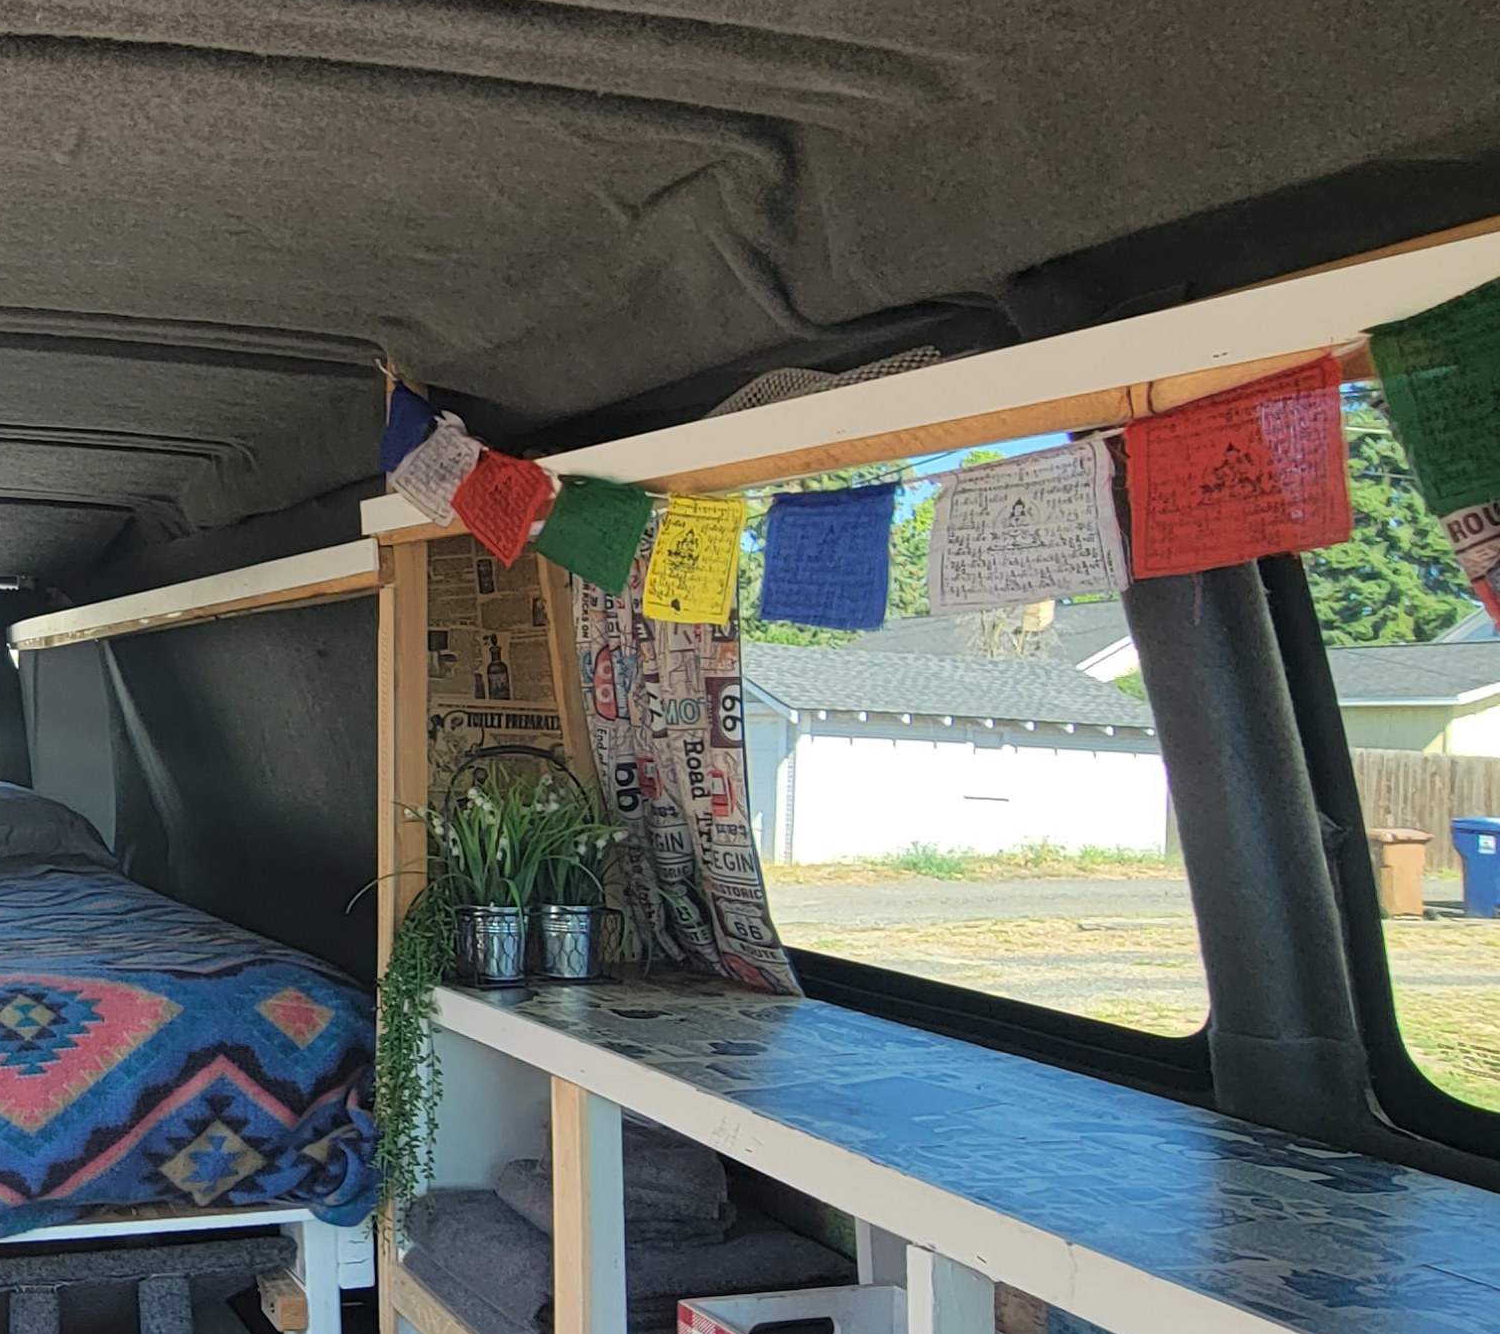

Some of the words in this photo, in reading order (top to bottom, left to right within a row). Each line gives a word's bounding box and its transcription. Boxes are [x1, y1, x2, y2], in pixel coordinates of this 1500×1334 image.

[721, 695, 743, 732] 66
[683, 739, 712, 801] Road
[712, 850, 755, 873] EGIN
[734, 921, 764, 941] 66
